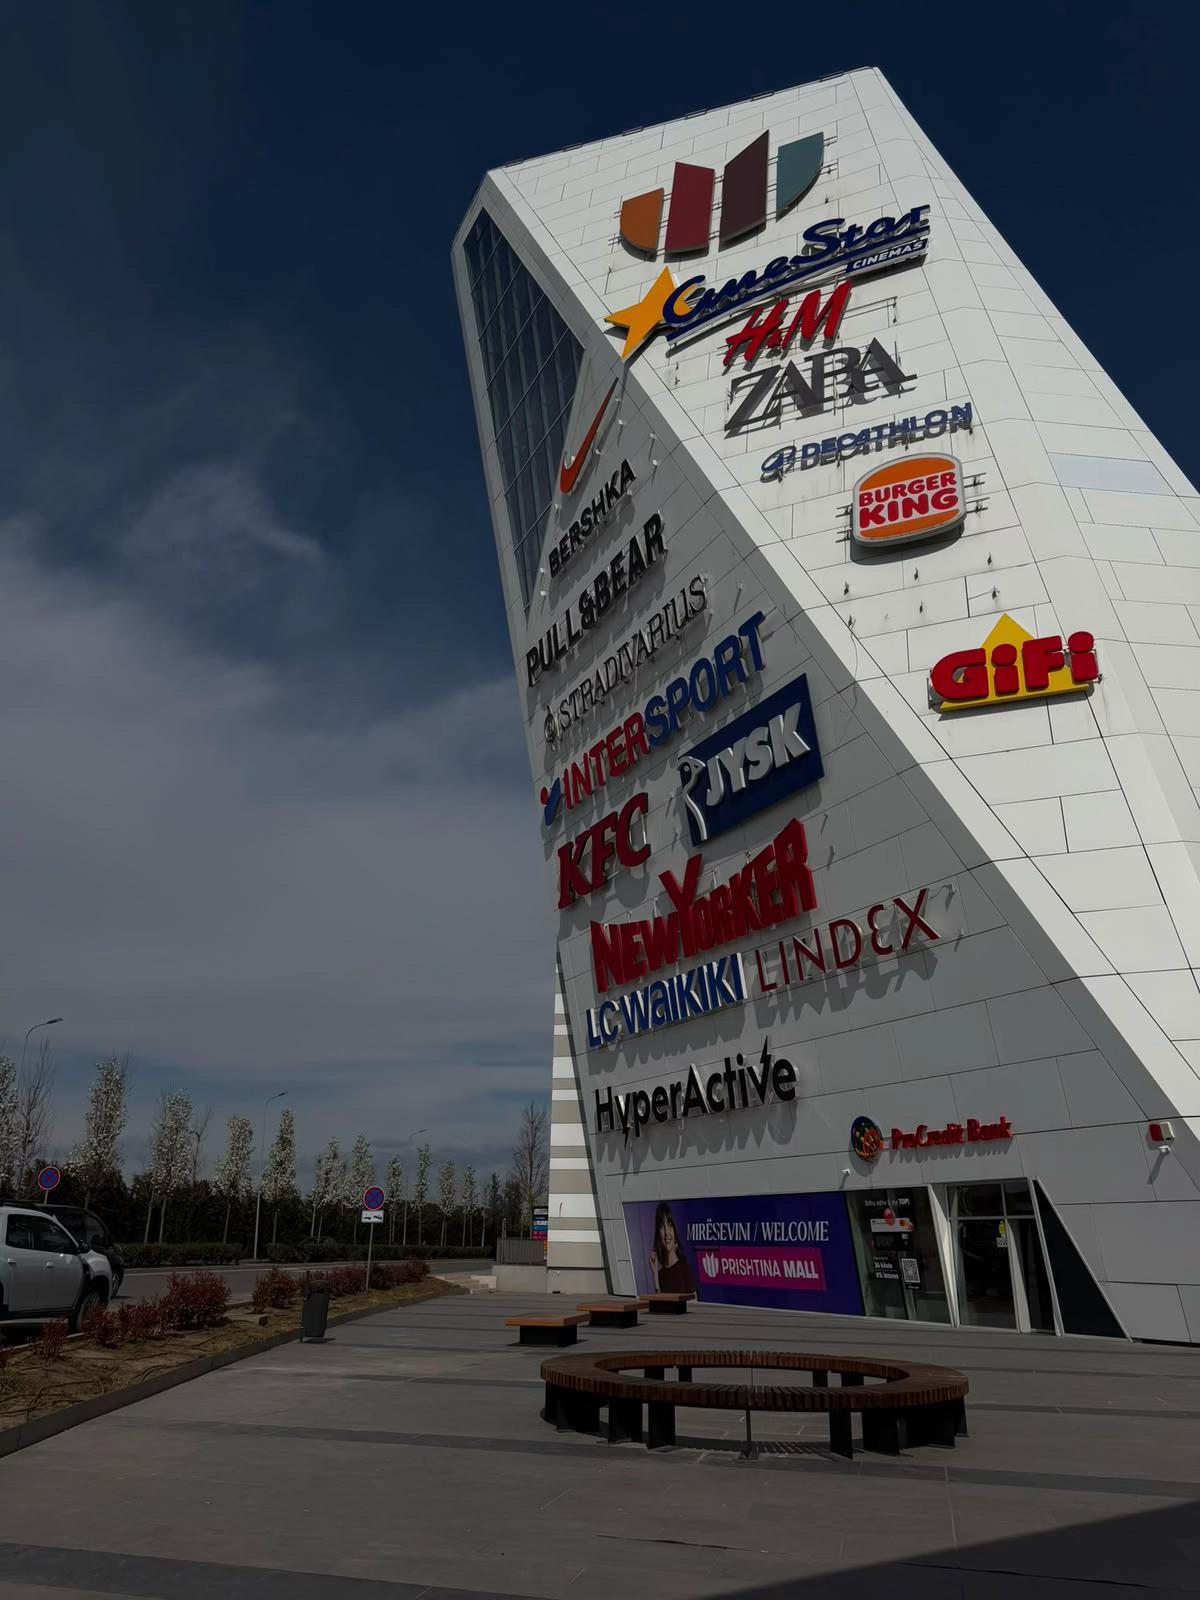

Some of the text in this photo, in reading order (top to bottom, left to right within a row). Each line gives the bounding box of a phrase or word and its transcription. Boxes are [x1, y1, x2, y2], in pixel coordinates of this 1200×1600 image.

[851, 241, 926, 269] CINEMAS
[724, 279, 852, 365] H&M
[724, 337, 917, 432] ZARA
[802, 402, 973, 460] DECATHLON
[549, 459, 638, 578] BERSHKA
[858, 472, 957, 507] BURGER
[858, 488, 959, 529] KING
[526, 512, 668, 687] PULL&BEAR
[557, 574, 709, 730] STRADIVARIUS
[930, 631, 1099, 701] GiFi
[563, 610, 767, 811] INTERSPORT
[705, 702, 811, 807] JYSK
[557, 792, 651, 910] KFC
[755, 888, 941, 992] LINDEX
[595, 1035, 798, 1149] HyperActive
[891, 1116, 1012, 1150] ProCredit Bank
[687, 1218, 751, 1241] MIRËSEVINI
[761, 1220, 830, 1242] WELCOME
[721, 1258, 819, 1279] PRISHTINA MALL
